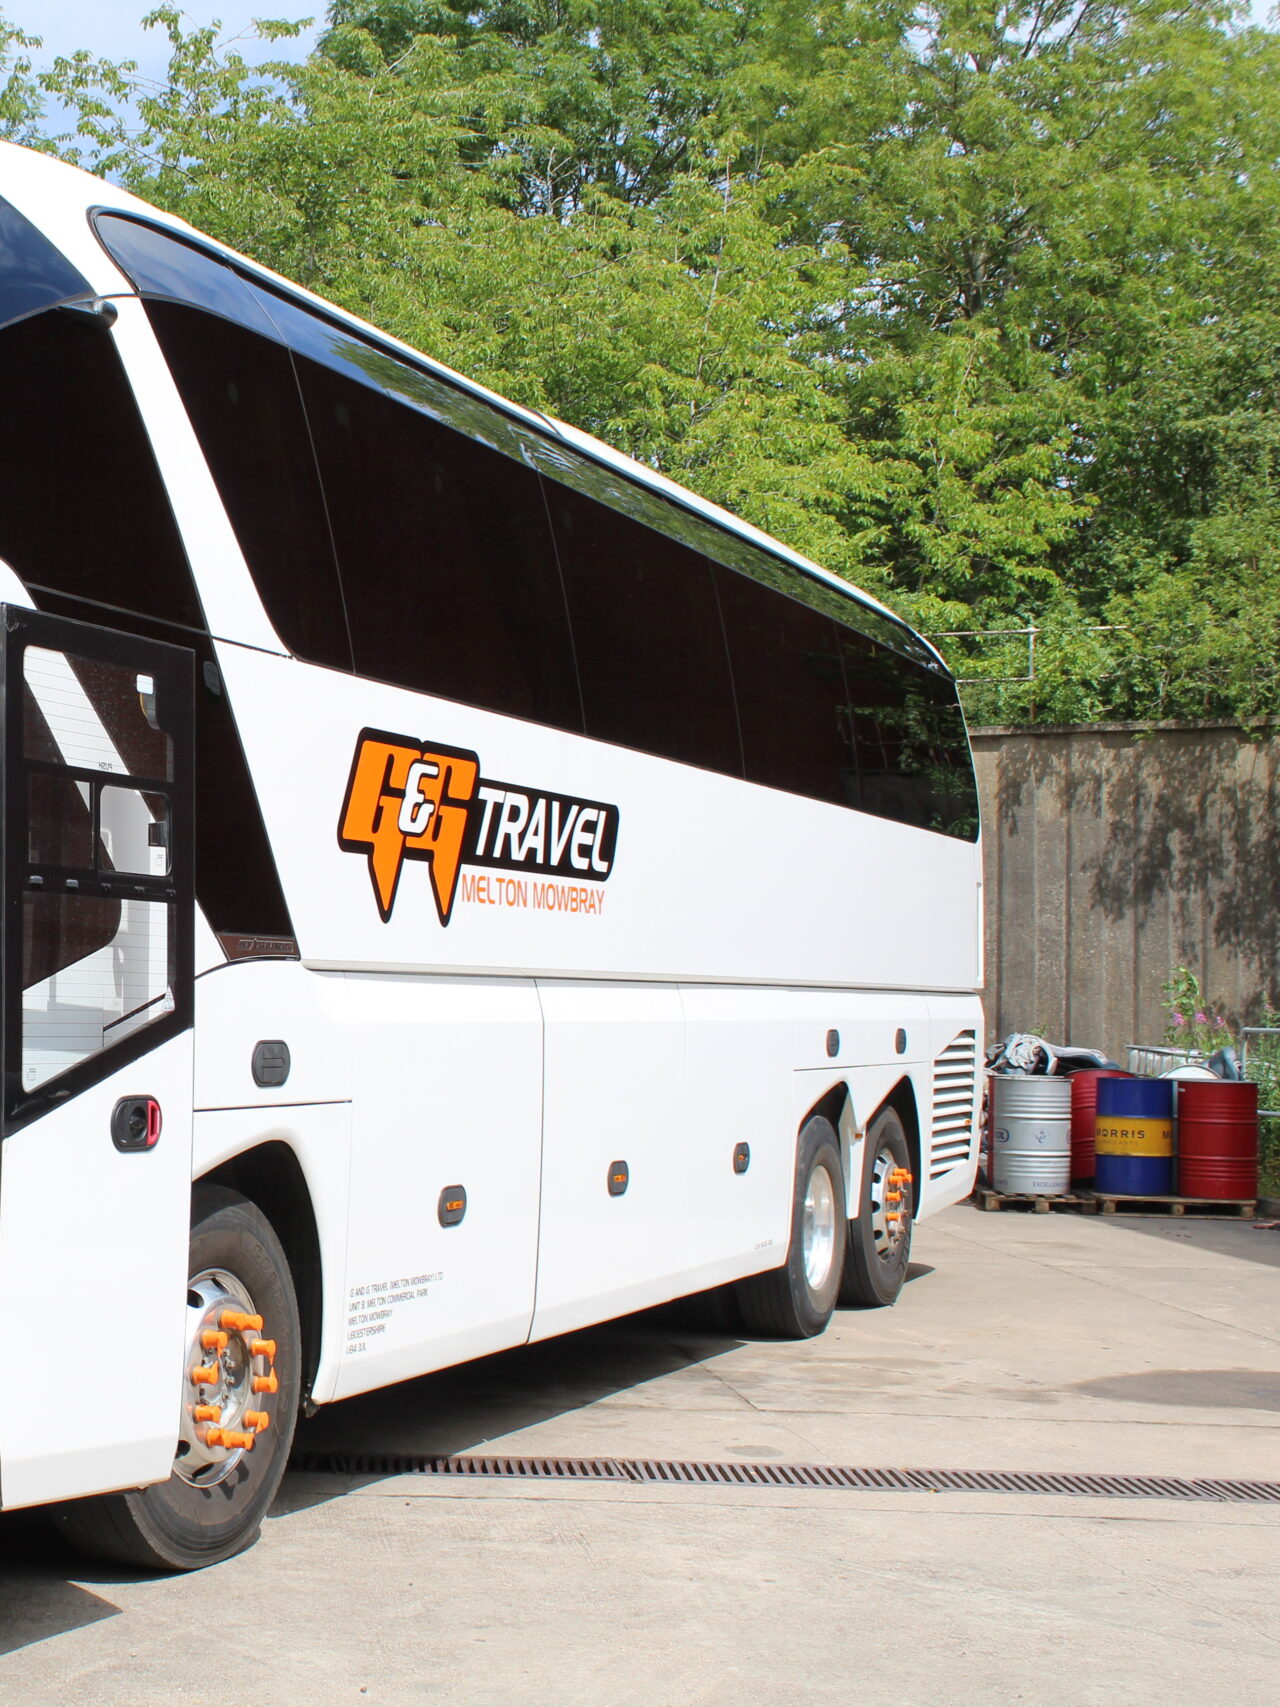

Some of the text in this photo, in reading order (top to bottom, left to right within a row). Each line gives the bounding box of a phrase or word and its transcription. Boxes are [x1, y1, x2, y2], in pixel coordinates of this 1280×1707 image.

[475, 785, 610, 873] TRAVEL
[461, 873, 605, 915] MELTON MOWBRAY
[349, 1300, 361, 1312] UNIT
[366, 1296, 387, 1309] MELTON
[387, 1290, 416, 1304] COMMERCIAL
[416, 1288, 429, 1298] PARK
[355, 1286, 366, 1297] AND
[371, 1282, 389, 1294] TRAVEL
[348, 1309, 393, 1326] MELTON MOWBRAY
